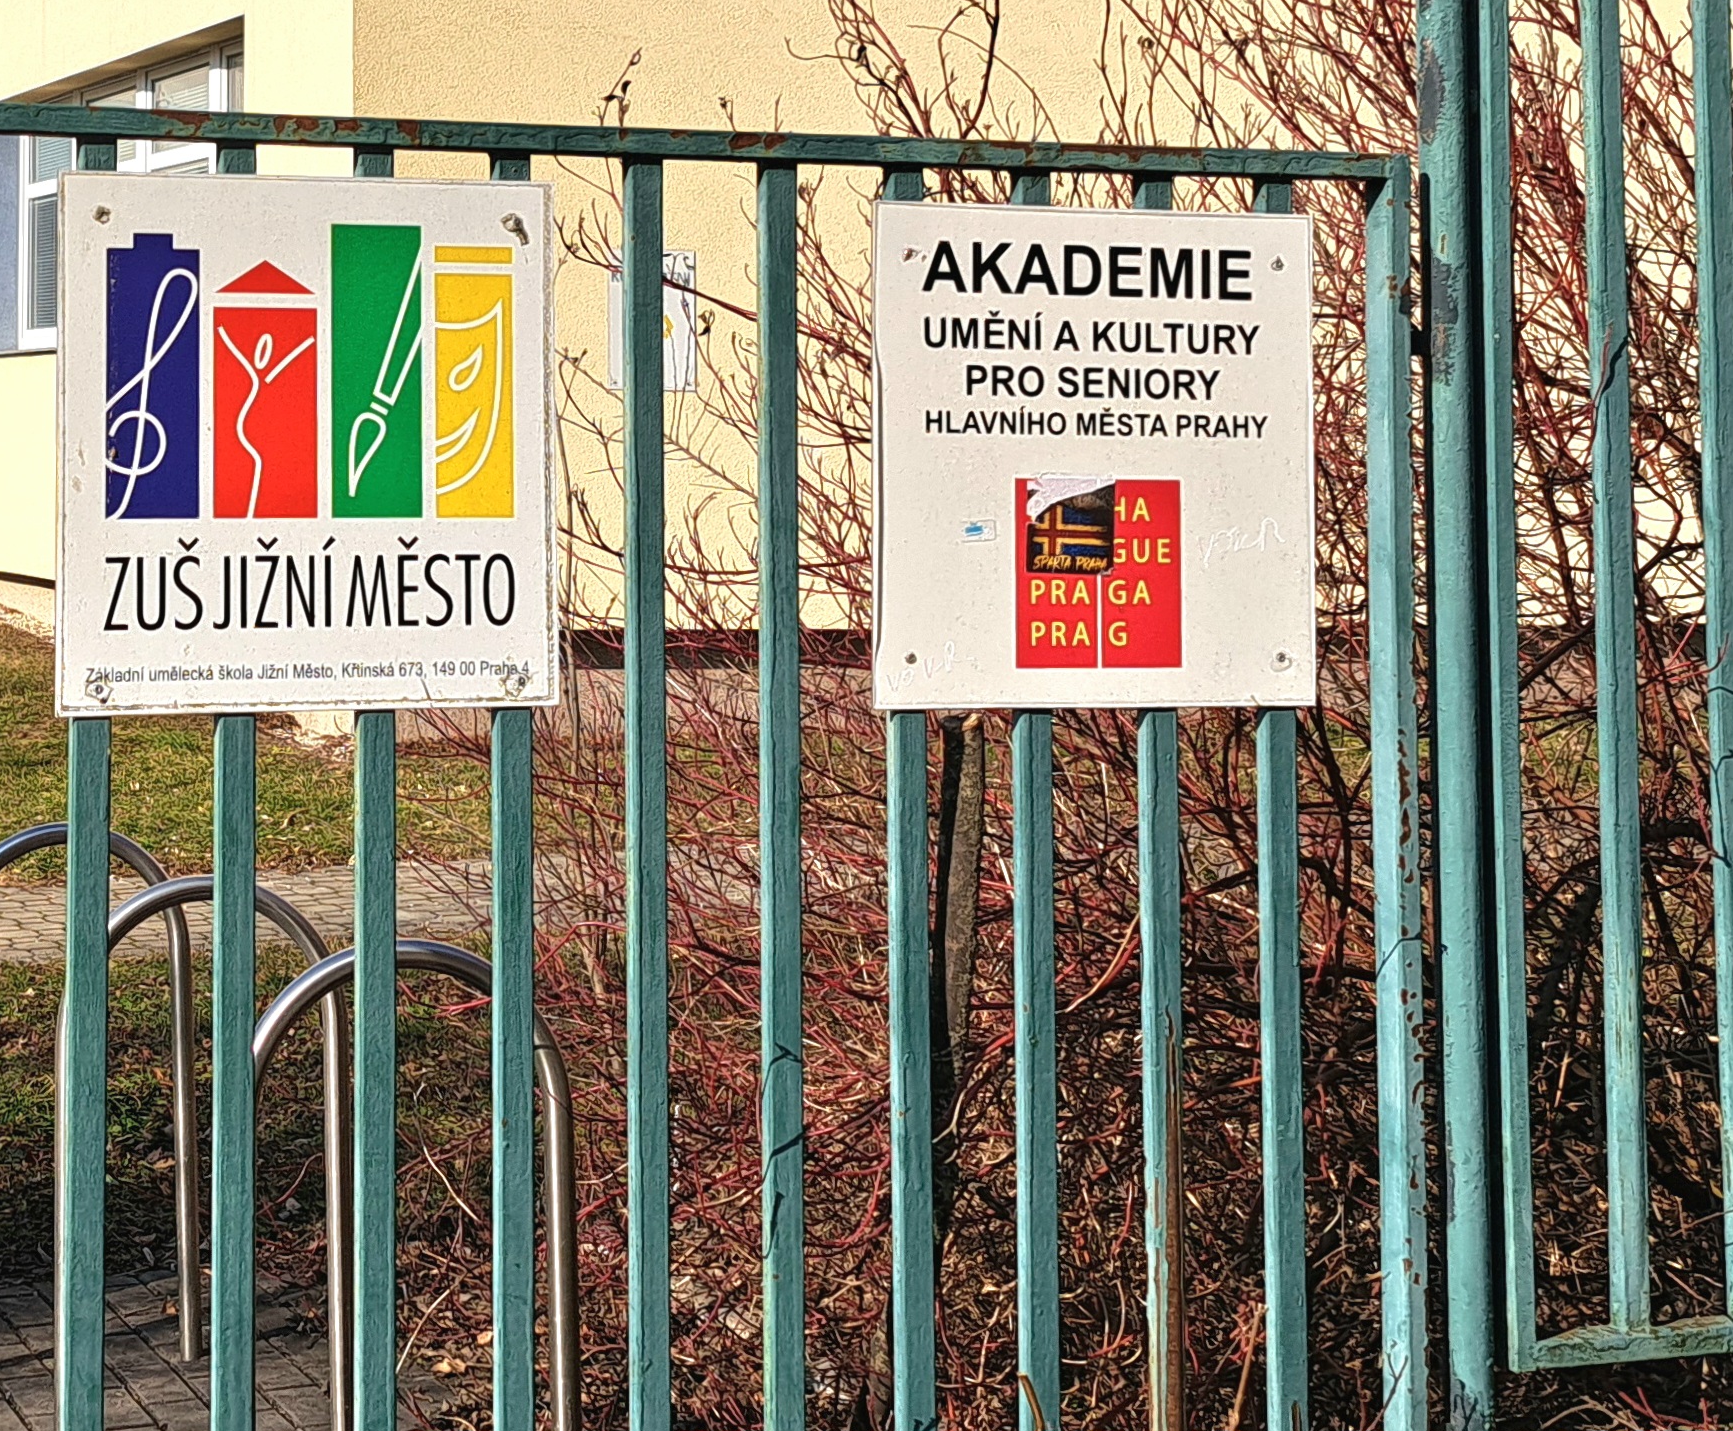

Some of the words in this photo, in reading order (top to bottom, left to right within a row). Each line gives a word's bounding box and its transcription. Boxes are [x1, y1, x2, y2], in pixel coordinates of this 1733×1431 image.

[922, 240, 1254, 301] AKADEMIE
[923, 310, 1043, 351] UMĚNÍ
[1053, 321, 1080, 352] A
[1092, 321, 1260, 356] KULTURY
[965, 364, 1045, 398] PRO
[1057, 367, 1221, 401] SENIORY
[924, 405, 1067, 436] HLAVNÍHO
[1075, 407, 1168, 438] MĚSTA
[1176, 413, 1269, 439] PRAHY
[1033, 555, 1072, 572] SPARTA
[103, 536, 204, 632] ZUŠ
[213, 535, 336, 630] JIŽNÍ
[345, 535, 517, 628] MĚSTO
[85, 666, 145, 684] Základní
[148, 664, 214, 682] umělecká
[217, 663, 254, 681] škola
[257, 662, 289, 680] Jižní
[292, 662, 338, 681] Město,
[341, 661, 395, 679] Křtinská
[398, 662, 428, 679] 673,
[431, 661, 456, 677] 149
[459, 661, 477, 677] 00
[479, 661, 518, 677] Praha
[520, 660, 530, 676] 4
